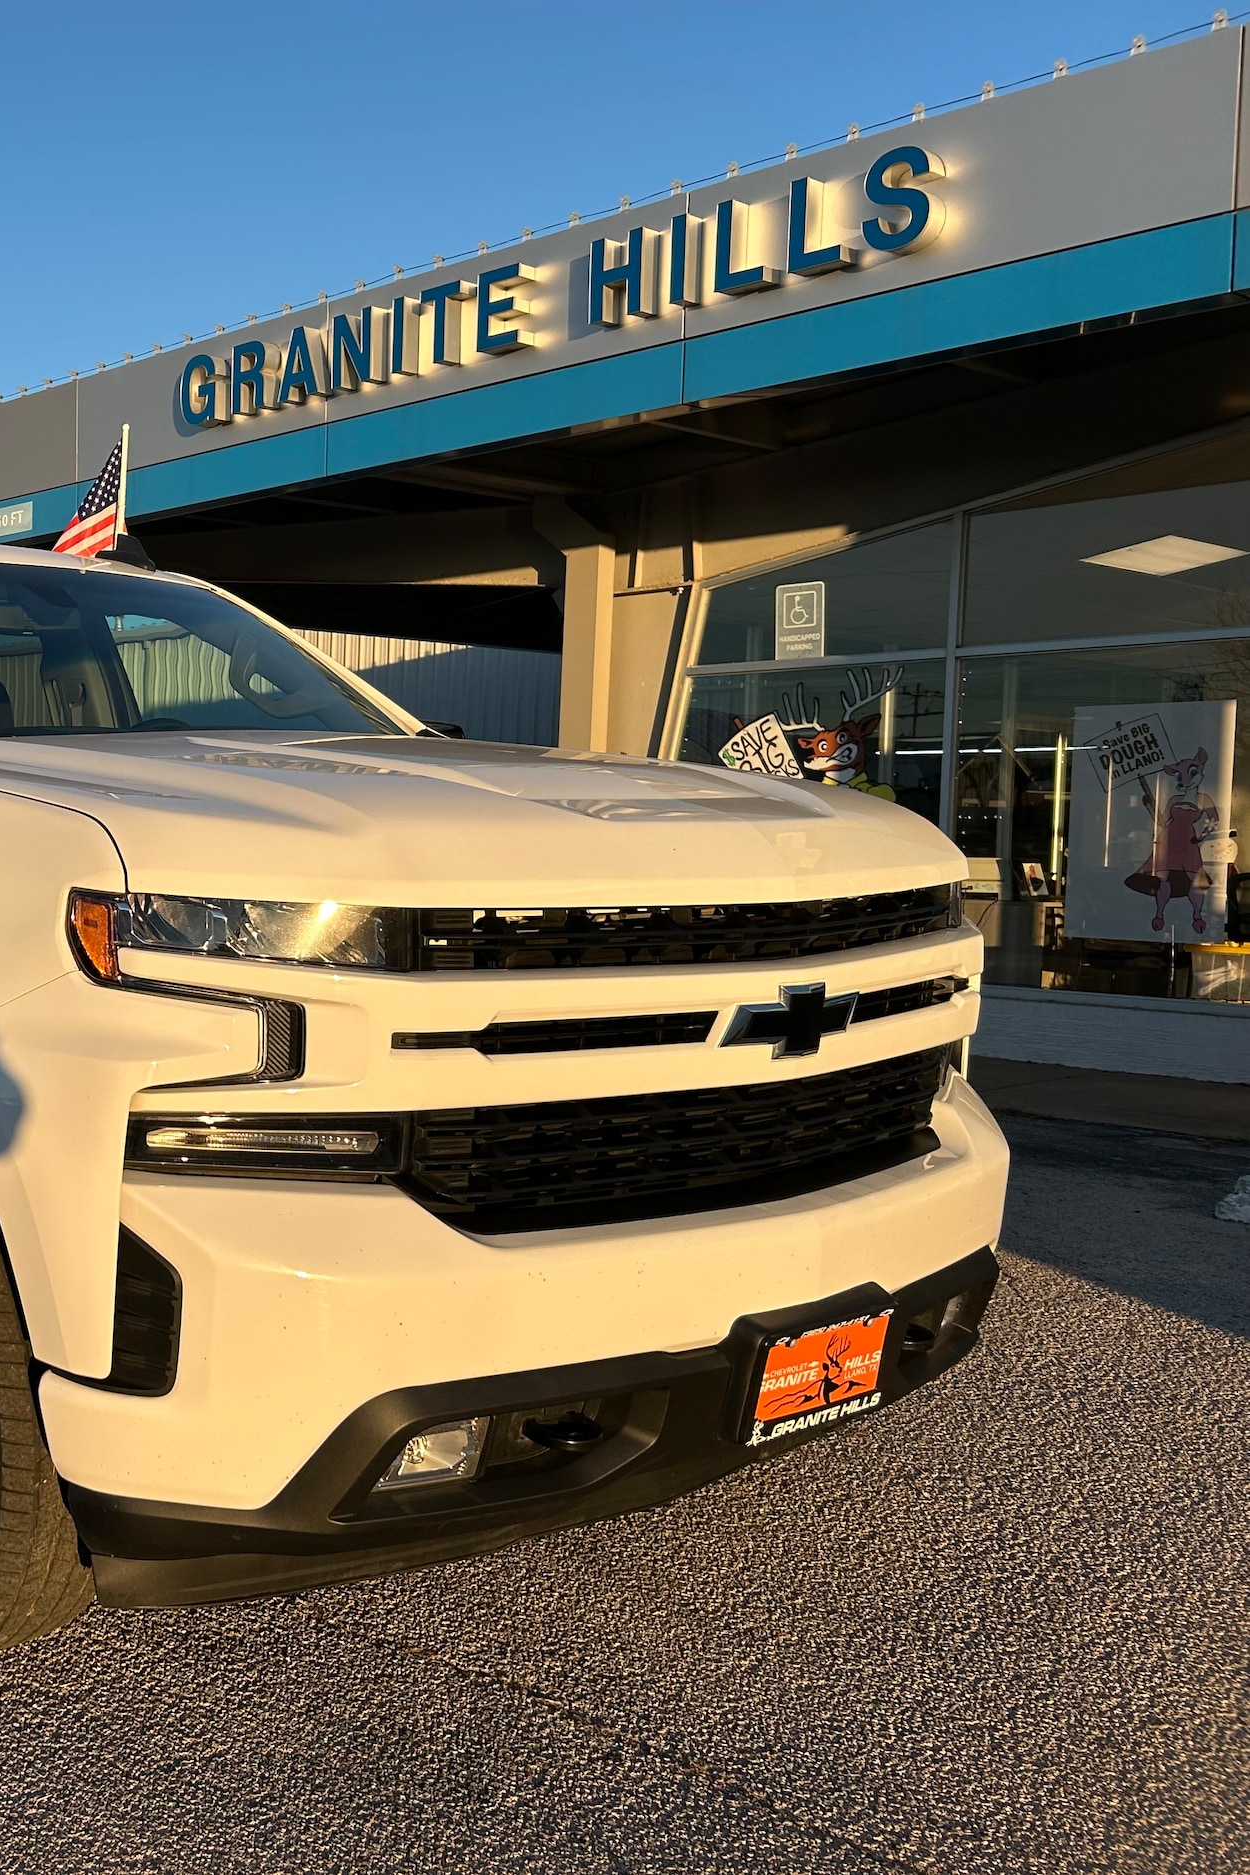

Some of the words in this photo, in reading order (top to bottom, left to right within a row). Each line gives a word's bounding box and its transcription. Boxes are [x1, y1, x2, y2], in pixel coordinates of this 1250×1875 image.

[180, 262, 535, 427] GRANITE
[587, 145, 946, 328] HILLS
[10, 510, 24, 525] FT
[779, 633, 821, 643] HANDICAPPED
[786, 643, 813, 651] PARKING
[731, 718, 778, 761] SAVE
[1103, 733, 1130, 748] Save
[1130, 723, 1150, 738] BIG
[1099, 733, 1159, 770] DOUGH
[1121, 749, 1165, 775] LLANO!
[769, 1362, 808, 1377] CHEVROLET
[843, 1349, 882, 1371] HILLS
[869, 1362, 878, 1372] TX
[770, 1404, 841, 1438] GRANITE
[840, 1391, 882, 1417] HILLS
